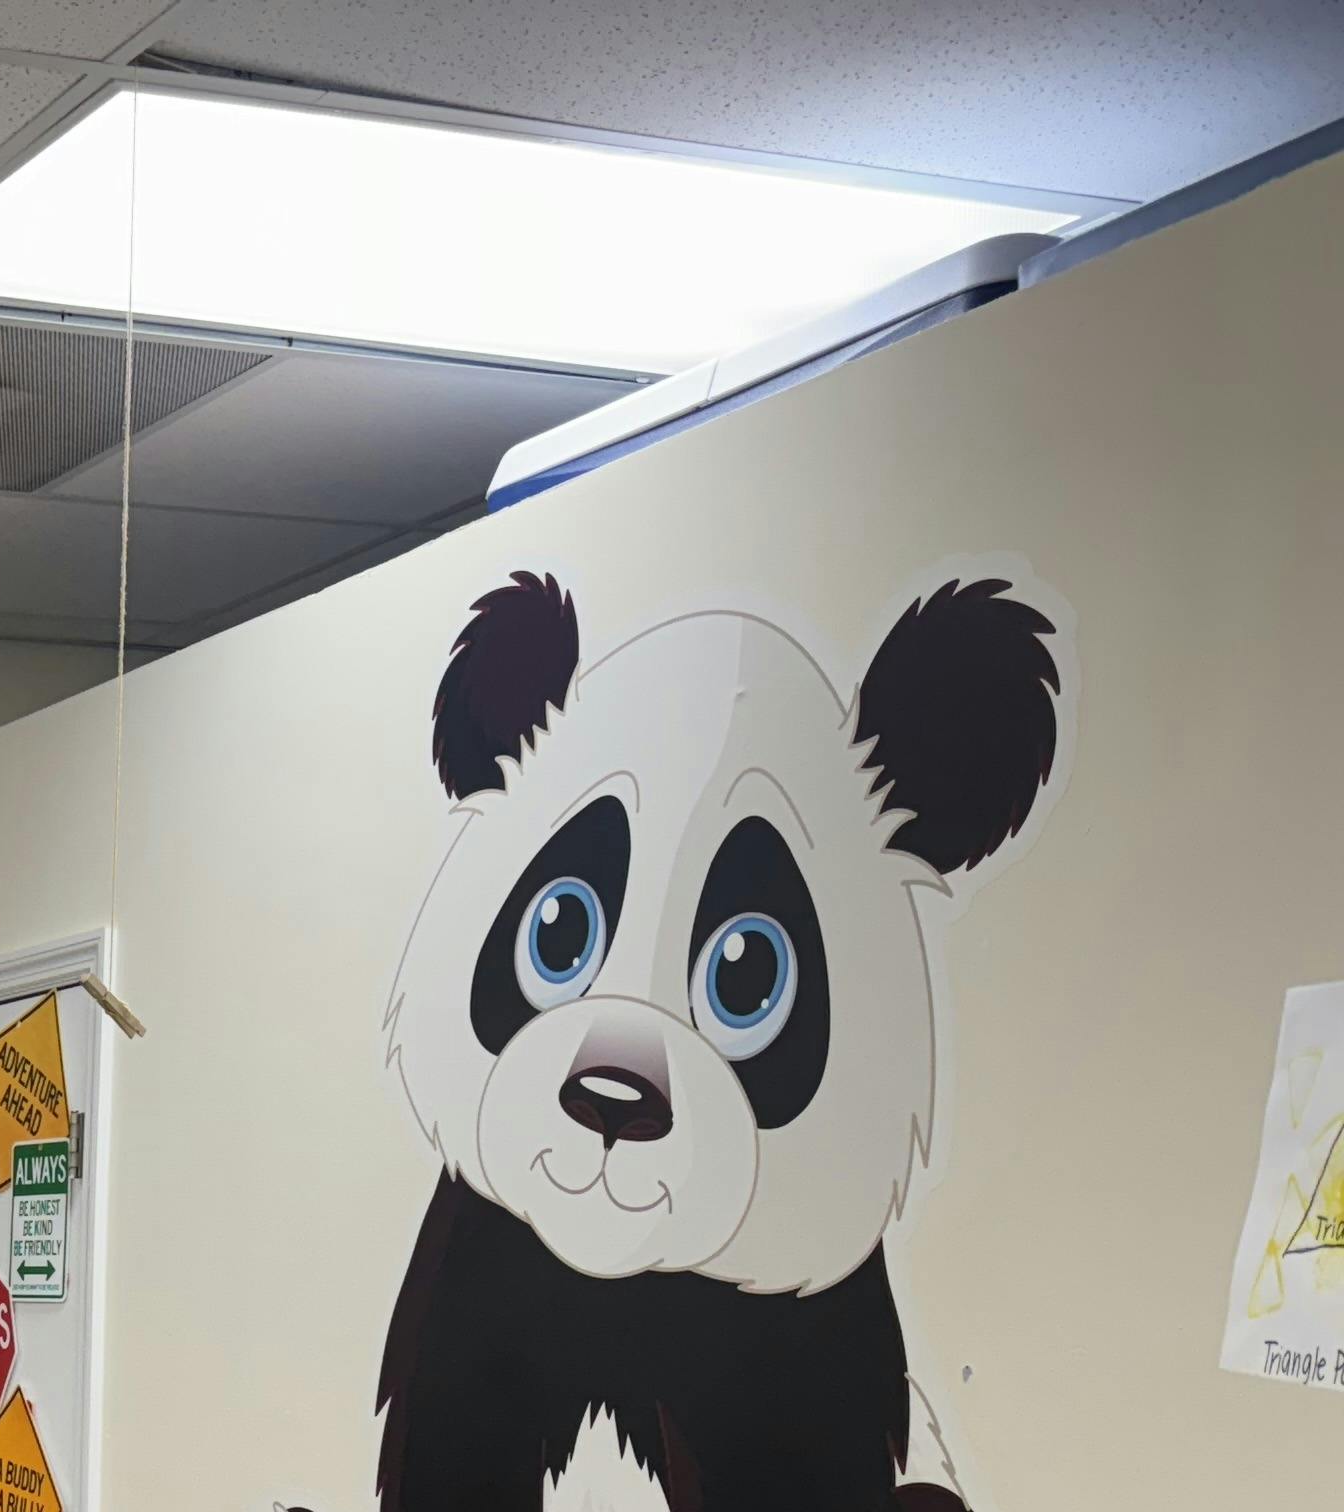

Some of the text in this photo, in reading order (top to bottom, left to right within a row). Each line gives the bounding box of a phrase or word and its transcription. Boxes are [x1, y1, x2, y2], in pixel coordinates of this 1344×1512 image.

[0, 1083, 43, 1137] AHEAD
[15, 1154, 67, 1185] ALWAYS
[19, 1199, 61, 1217] BE HONEST
[23, 1219, 53, 1236] BE KIND
[14, 1240, 63, 1256] BE FRIENDLY
[1263, 1340, 1327, 1385] Triangle
[5, 1460, 45, 1497] BUDDY
